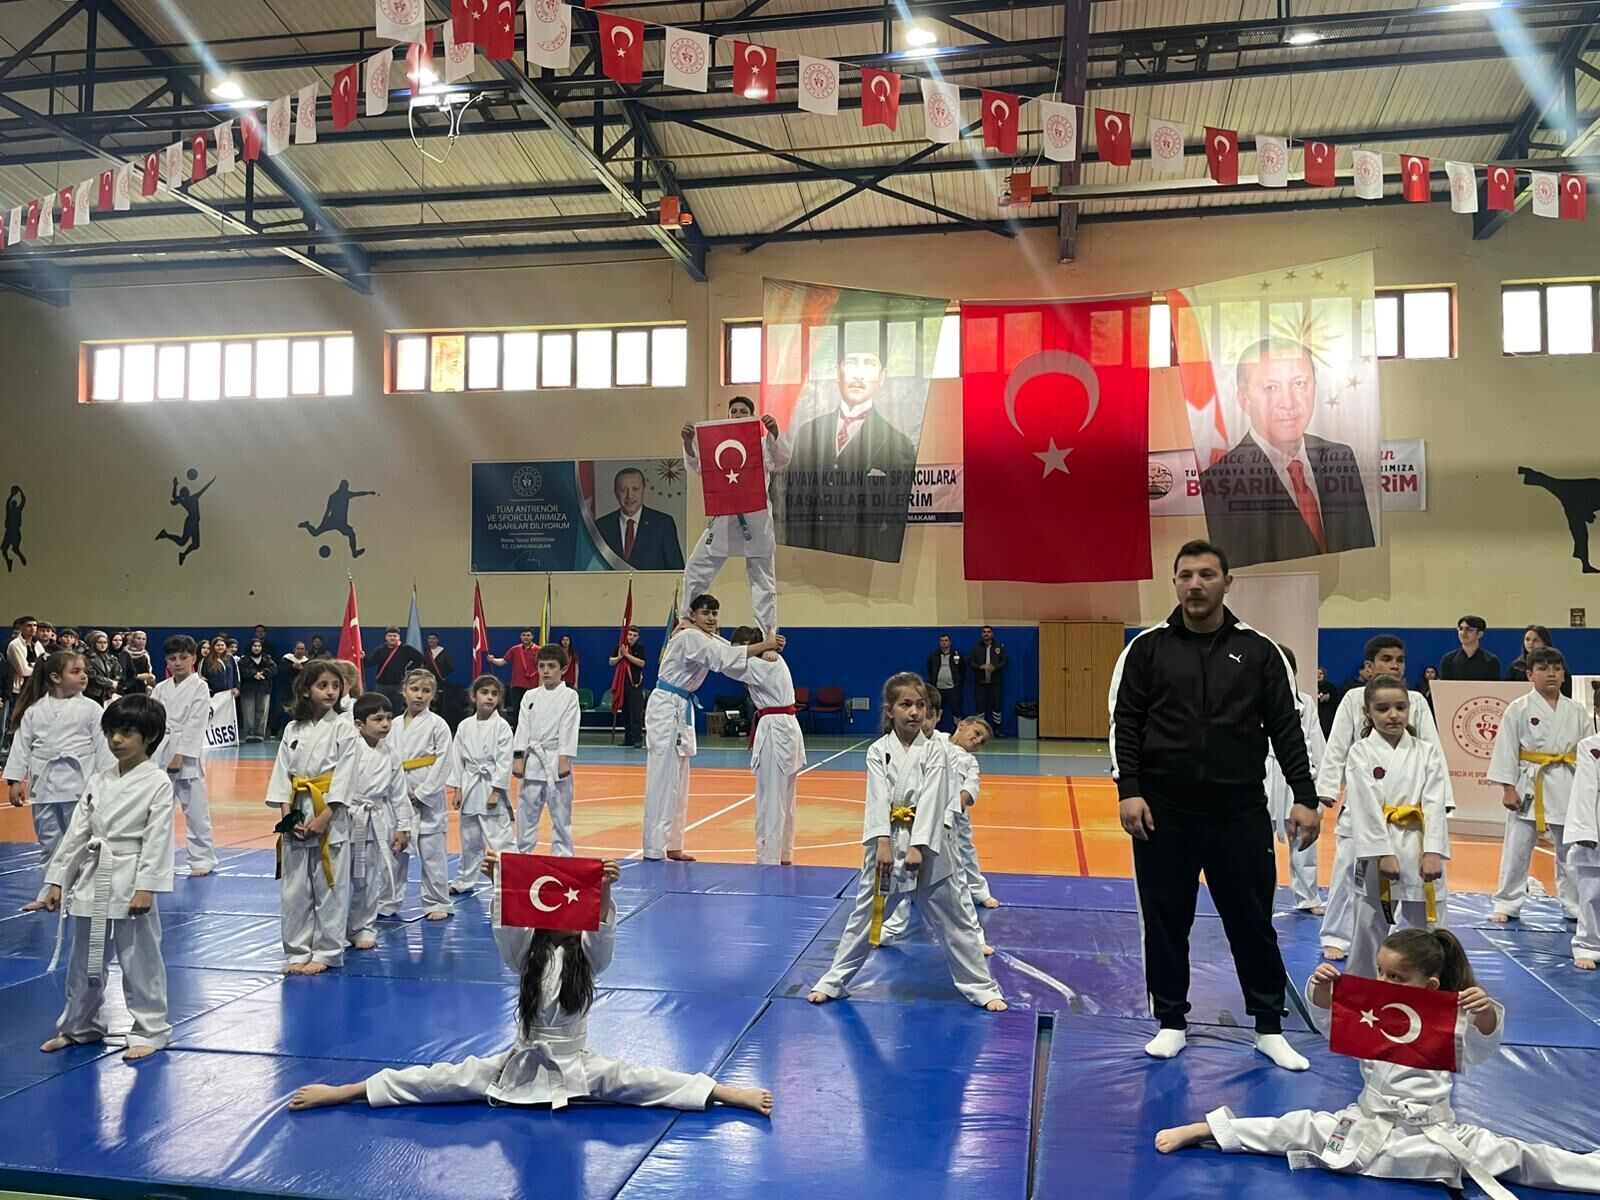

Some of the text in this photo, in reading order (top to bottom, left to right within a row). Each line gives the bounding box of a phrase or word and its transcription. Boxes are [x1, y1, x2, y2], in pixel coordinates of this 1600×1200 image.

[890, 469, 957, 486] SPORCULARA
[1186, 474, 1316, 499] BAŞARIL
[871, 490, 932, 508] DİLERİM
[496, 504, 558, 513] TÜM ANTRENÖR
[486, 513, 567, 522] VE SPORCULARIMIZA
[488, 522, 570, 531] BAŞARILAR DİLİYORUM
